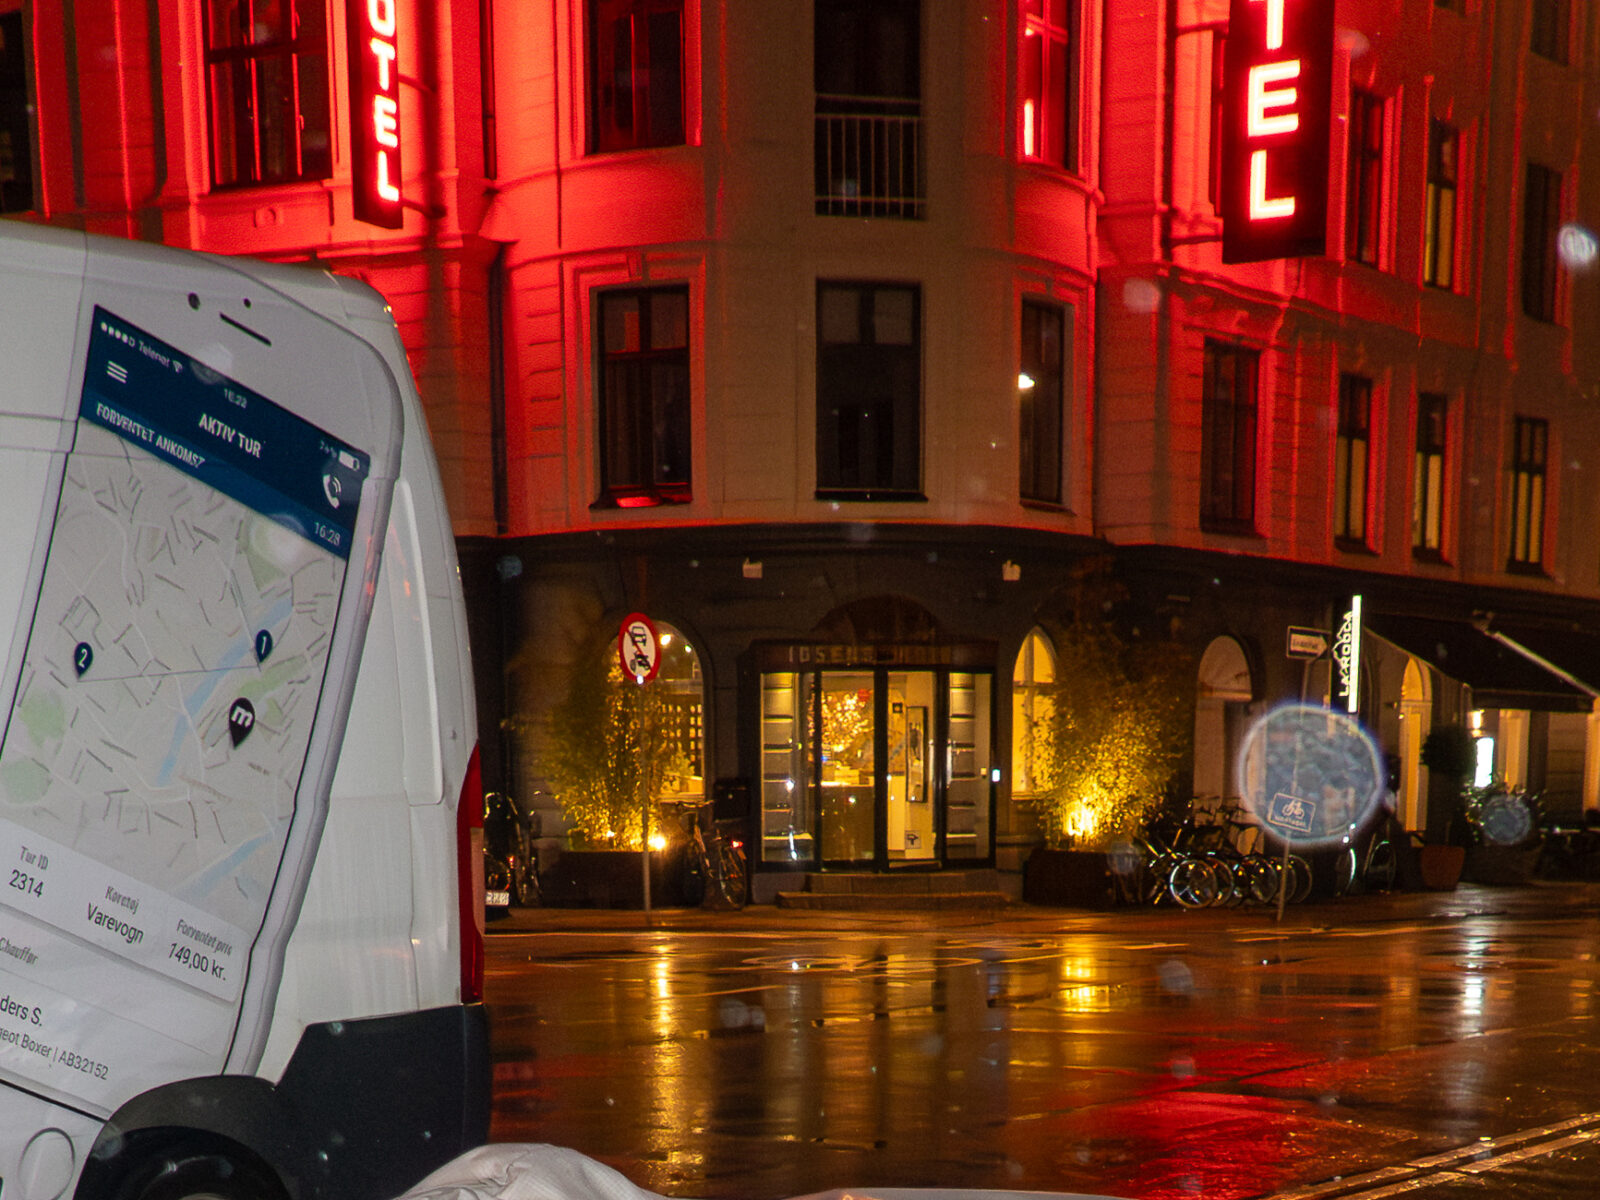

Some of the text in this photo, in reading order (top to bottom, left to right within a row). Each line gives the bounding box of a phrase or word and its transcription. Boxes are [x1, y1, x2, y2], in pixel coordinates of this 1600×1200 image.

[96, 402, 156, 443] FORVENTET
[198, 413, 262, 458] AKTIV TUR
[78, 648, 88, 669] 2
[37, 853, 49, 871] ID
[9, 868, 44, 898] 2314
[87, 902, 145, 944] Varevogn
[168, 942, 227, 981] 149,00 kr.
[30, 1006, 42, 1027] S.
[0, 1027, 20, 1046] eot
[20, 1033, 52, 1058] Boxer
[58, 1050, 109, 1081] AB32152
